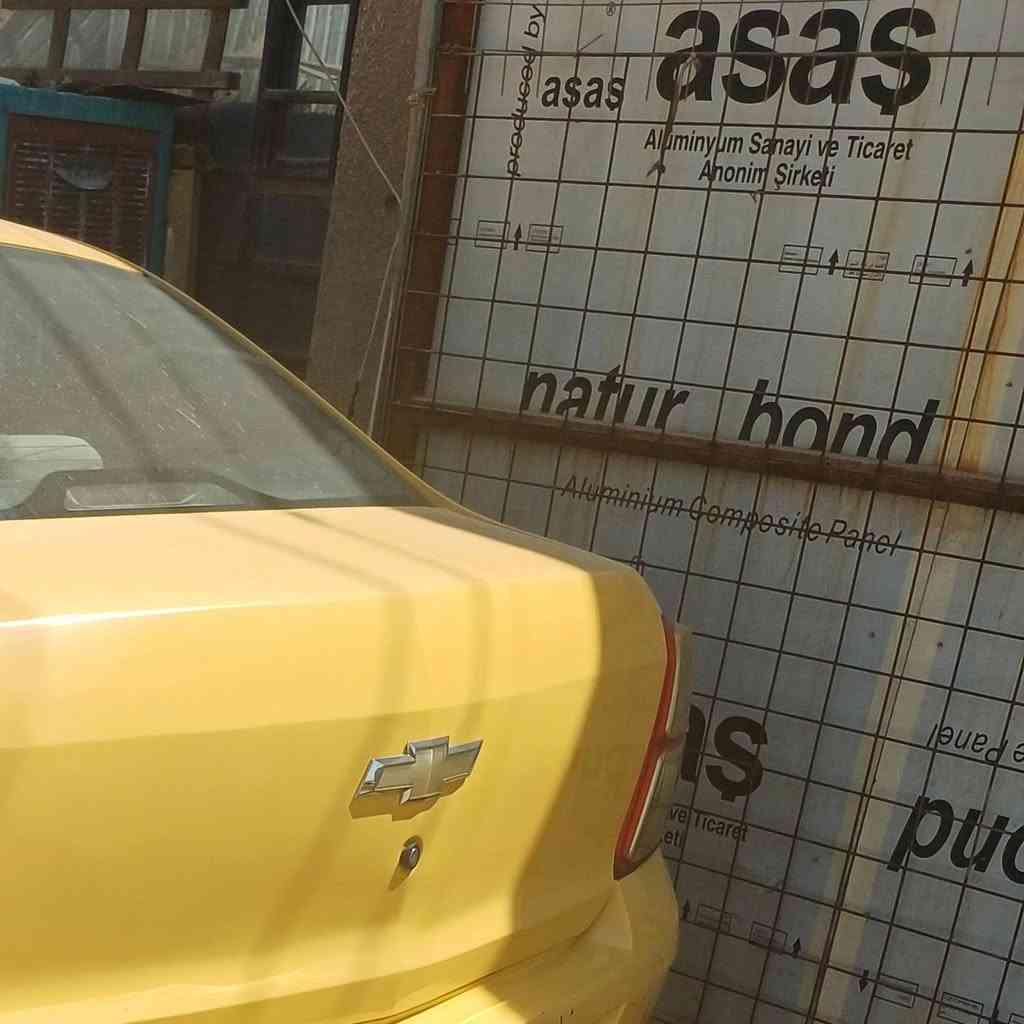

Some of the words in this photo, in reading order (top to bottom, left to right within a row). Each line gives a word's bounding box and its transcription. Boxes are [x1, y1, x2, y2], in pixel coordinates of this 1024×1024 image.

[506, 46, 537, 177] produced
[523, 4, 545, 38] by
[644, 128, 744, 158] Aluminyum
[748, 131, 814, 161] Sanayi
[817, 139, 840, 157] ve
[846, 135, 914, 160] Ticaret
[698, 159, 769, 184] Anonim
[773, 162, 836, 191] Şirketi
[520, 365, 691, 429] natur
[738, 378, 941, 464] bond
[561, 474, 682, 518] Aluminium
[688, 495, 822, 541] Composite
[825, 518, 903, 557] Panel
